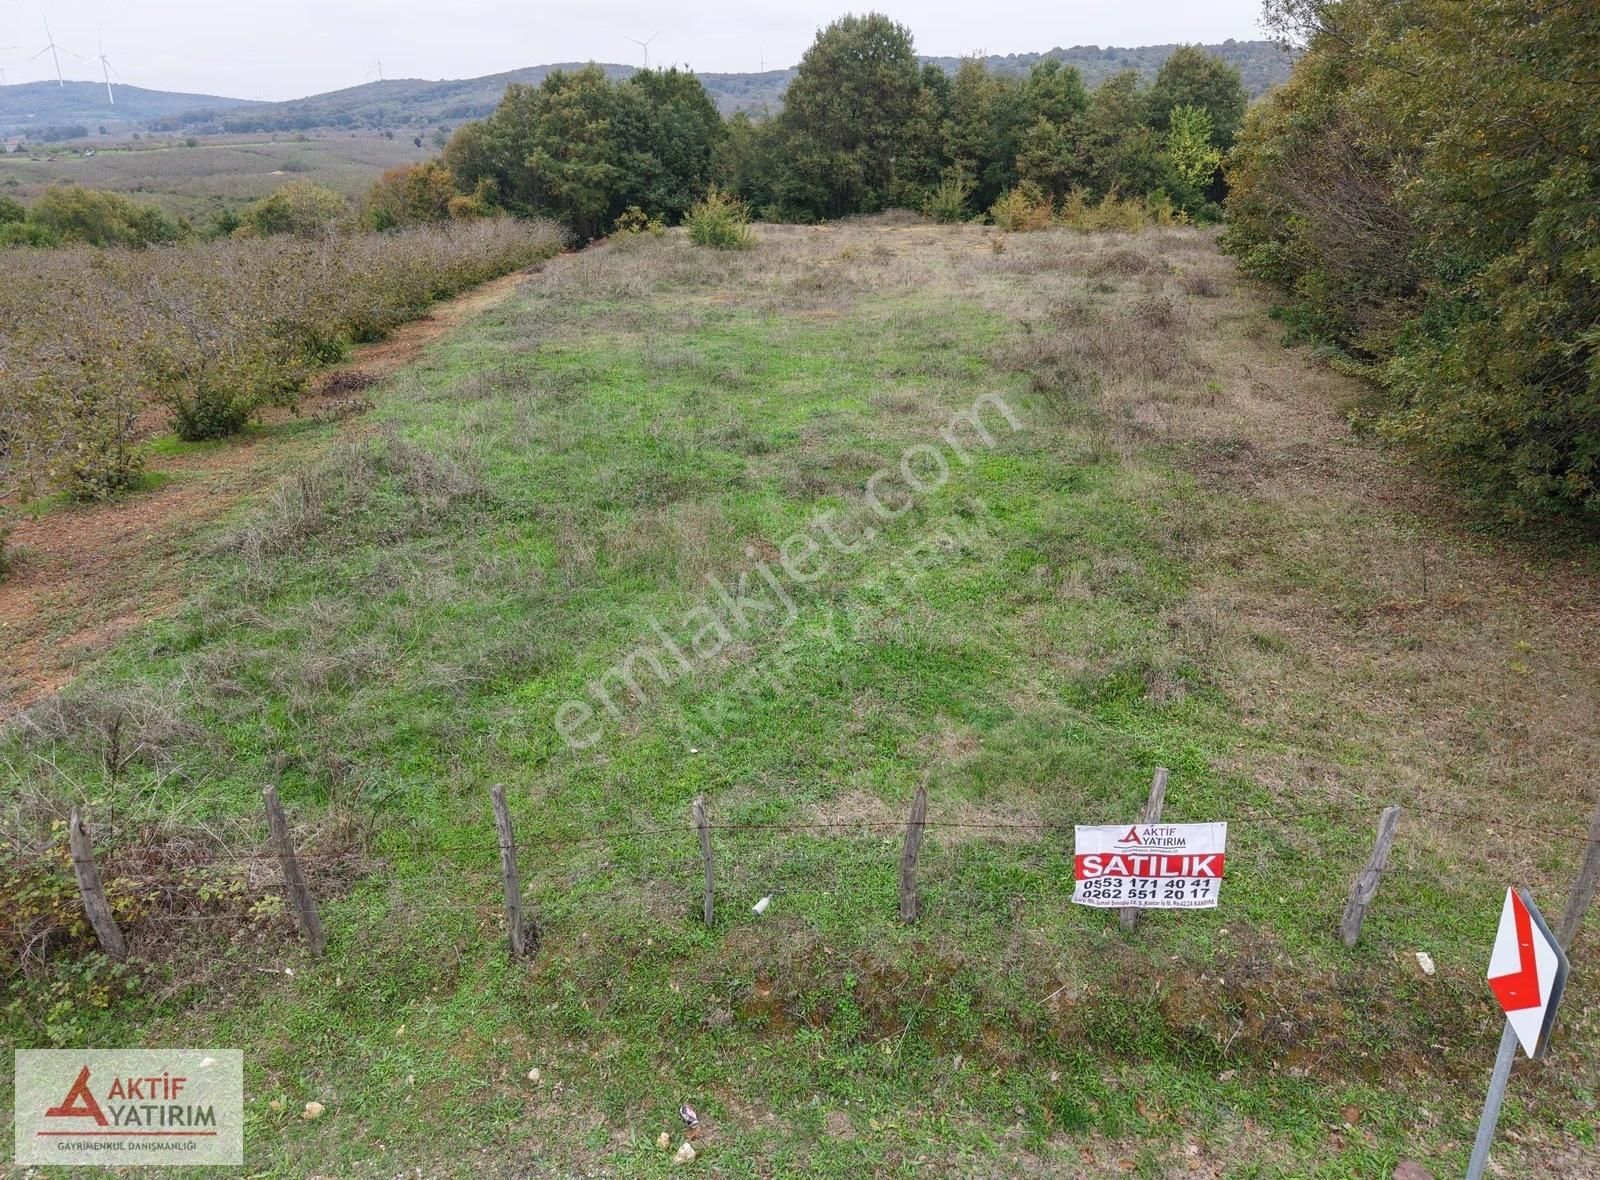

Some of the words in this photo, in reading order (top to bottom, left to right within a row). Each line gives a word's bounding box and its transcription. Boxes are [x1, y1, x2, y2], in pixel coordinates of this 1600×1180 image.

[1142, 837, 1186, 846] YATIRIM
[1082, 855, 1217, 878] SATILIK
[1084, 878, 1123, 890] 0553
[1129, 878, 1158, 889] 171
[1165, 879, 1186, 889] 40
[1190, 878, 1211, 888] 41
[1082, 889, 1122, 900] 0262
[1128, 889, 1158, 899] 551
[1164, 889, 1185, 900] 20
[1190, 888, 1211, 898] 17
